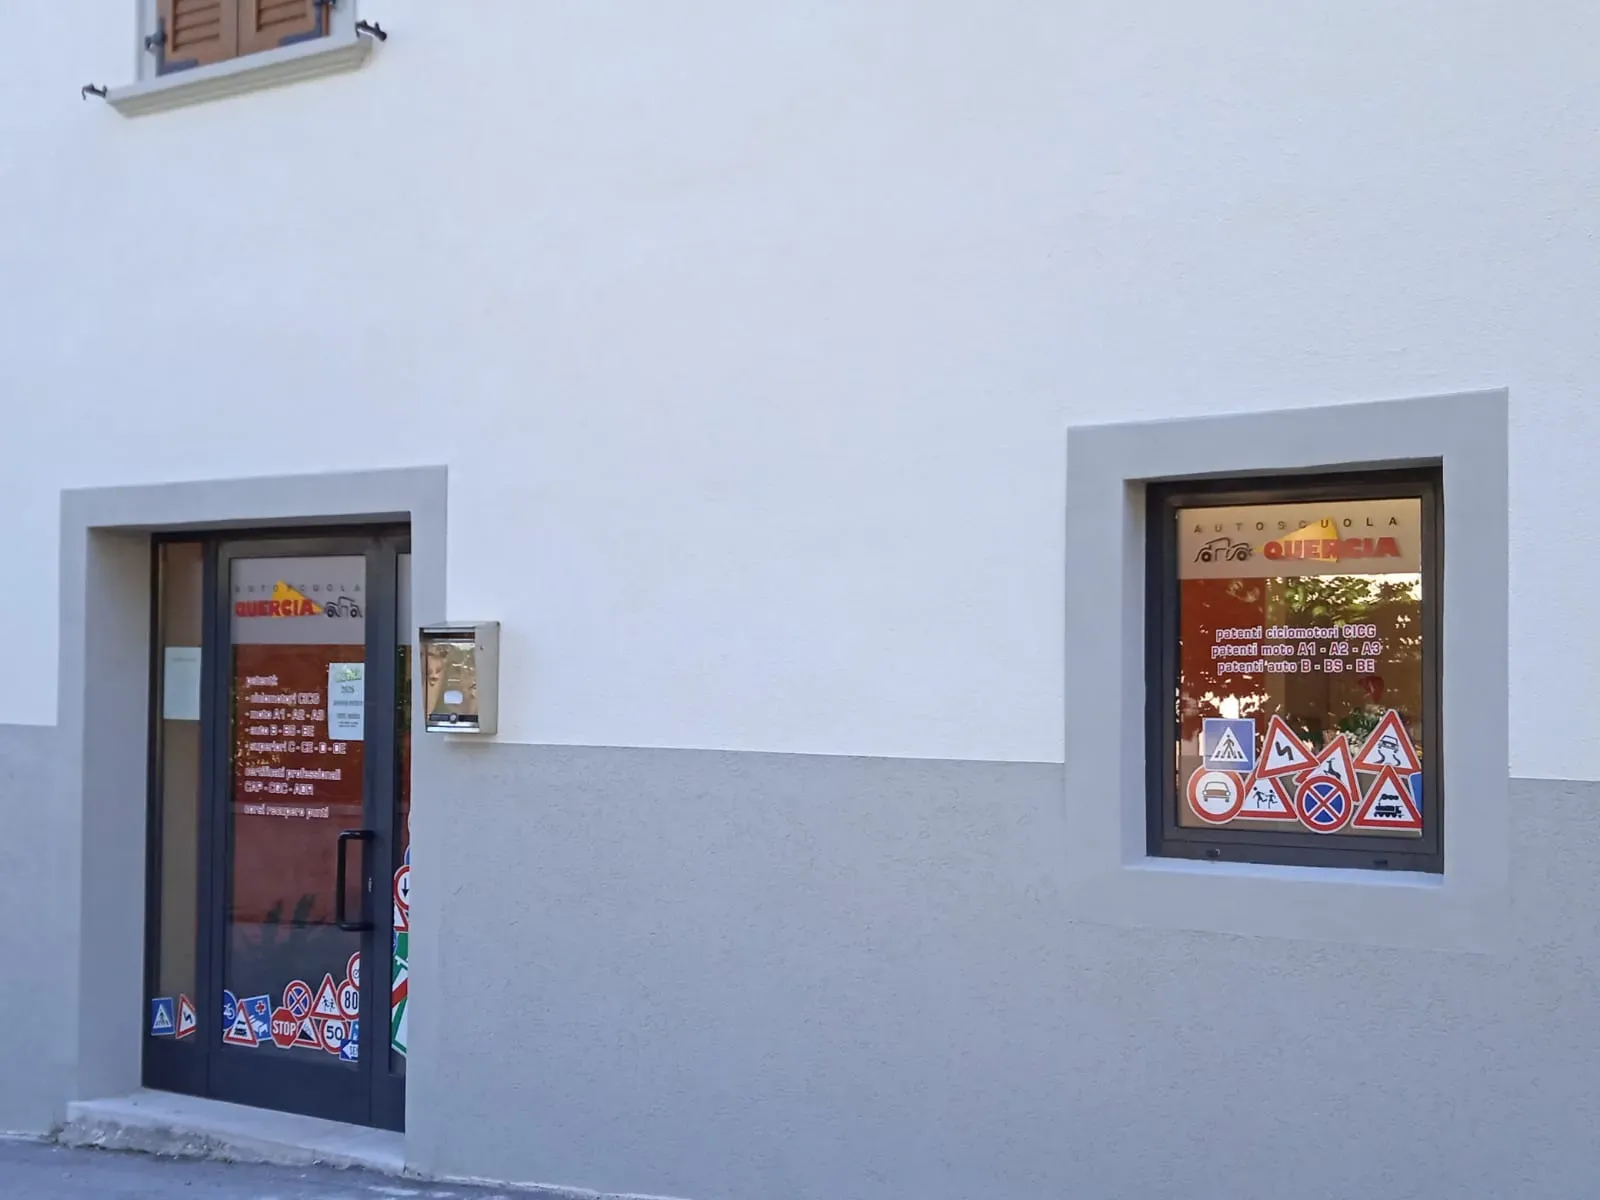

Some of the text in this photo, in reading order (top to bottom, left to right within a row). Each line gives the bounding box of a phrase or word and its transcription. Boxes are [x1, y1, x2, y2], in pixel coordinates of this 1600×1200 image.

[1194, 516, 1398, 534] AUTOSCUOLA
[1263, 536, 1402, 561] QUERCIA
[234, 598, 316, 618] QUERCIA
[1215, 623, 1377, 643] patenti ciclomotori CICG
[1211, 642, 1258, 659] patenti
[1261, 644, 1294, 656] moto
[1297, 641, 1316, 656] A1
[1329, 641, 1349, 656] A2
[1361, 641, 1381, 656] A3
[1217, 659, 1264, 676] patenti
[1267, 661, 1298, 673] auto
[1300, 659, 1312, 673] B
[1323, 658, 1344, 673] BS
[1355, 659, 1375, 673] BE
[344, 990, 359, 1010] 80
[272, 1020, 297, 1037] STOP
[325, 1025, 344, 1041] 50
